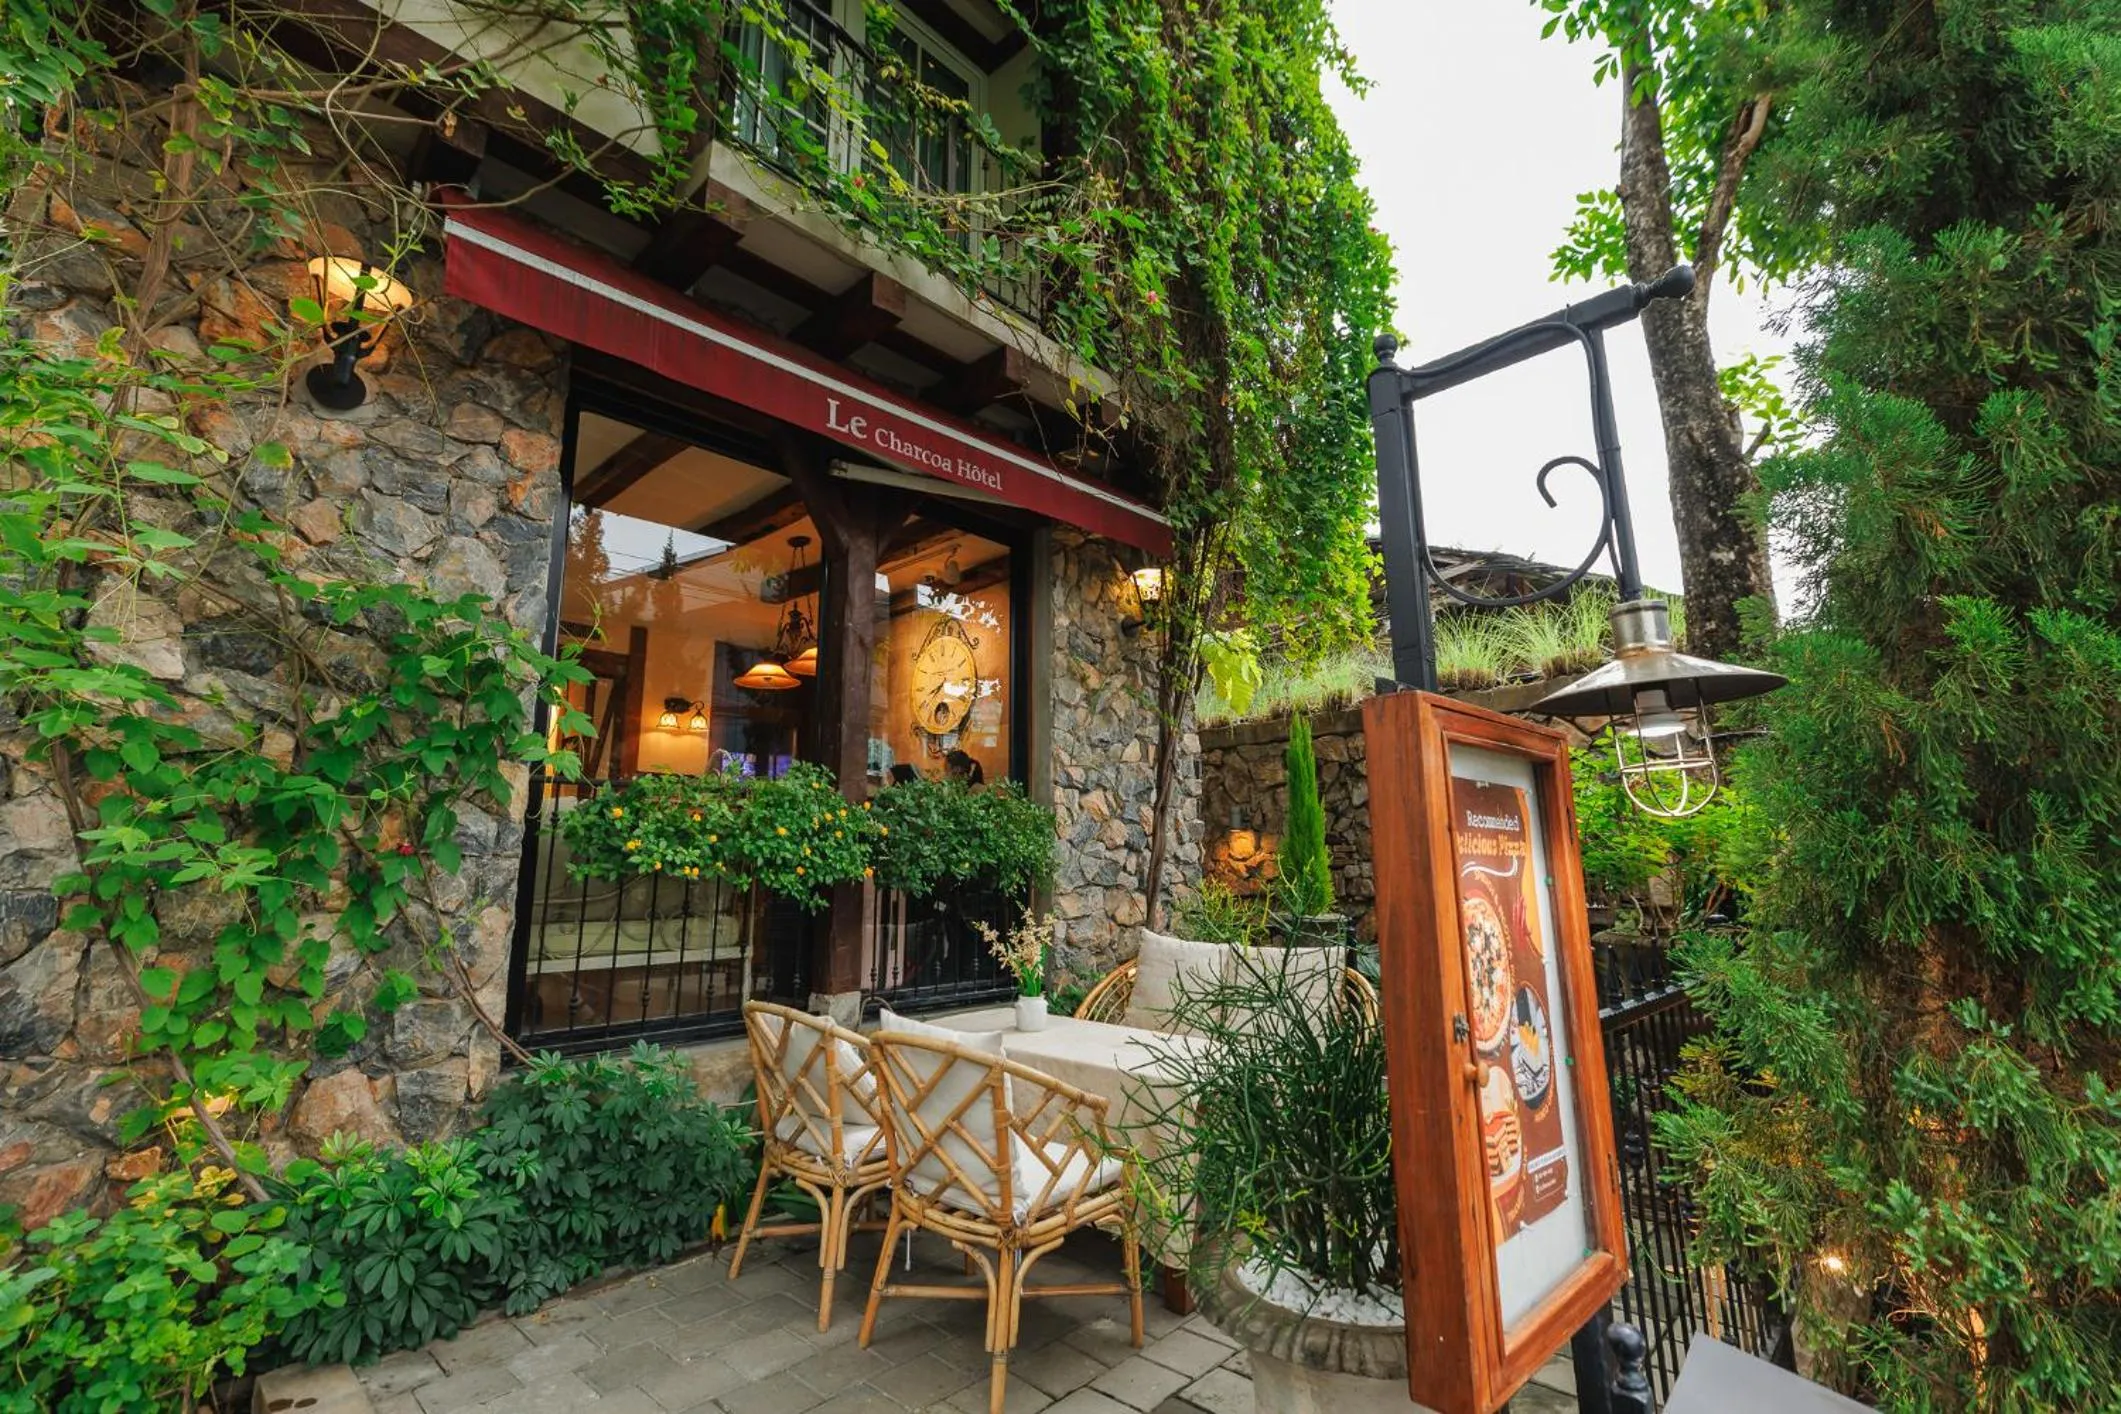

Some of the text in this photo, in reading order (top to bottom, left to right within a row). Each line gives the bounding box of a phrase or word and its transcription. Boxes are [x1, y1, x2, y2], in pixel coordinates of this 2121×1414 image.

[826, 398, 1004, 491] Le Charcoa Hôtel
